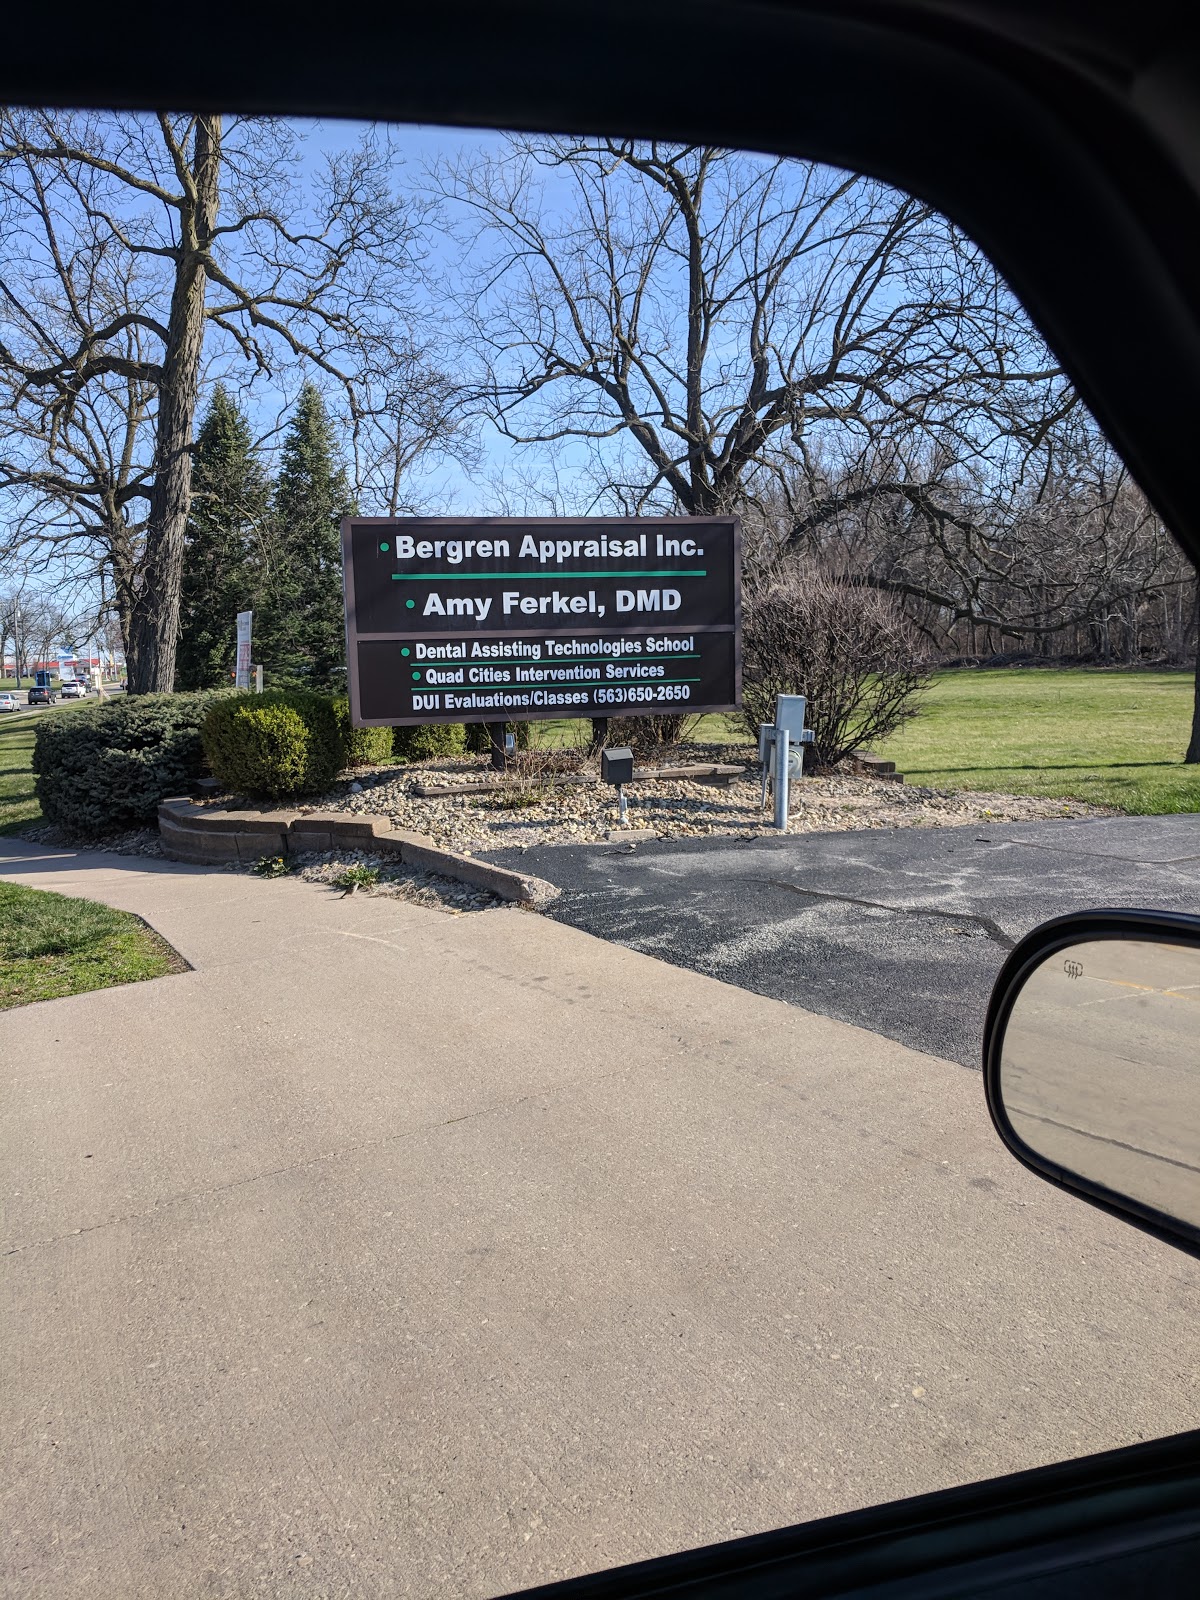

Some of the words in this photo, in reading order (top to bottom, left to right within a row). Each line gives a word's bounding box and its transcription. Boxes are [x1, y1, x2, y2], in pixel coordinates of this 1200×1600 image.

[396, 536, 509, 563] Bergren
[519, 535, 646, 563] Appraisal
[657, 535, 703, 556] Inc.
[423, 593, 492, 620] Amy
[503, 591, 605, 617] Ferkel,
[616, 590, 681, 611] DMD
[416, 642, 466, 659] Dental
[471, 641, 541, 659] Assisting
[545, 638, 642, 657] Technologies
[646, 636, 693, 652] School
[426, 668, 463, 684] Quad
[469, 668, 510, 682] Cities
[516, 665, 600, 681] Intervention
[606, 664, 664, 678] Services
[413, 695, 439, 710] DUI
[445, 691, 588, 708] Evaluations/Classes
[594, 685, 690, 703] (563)650-2650
